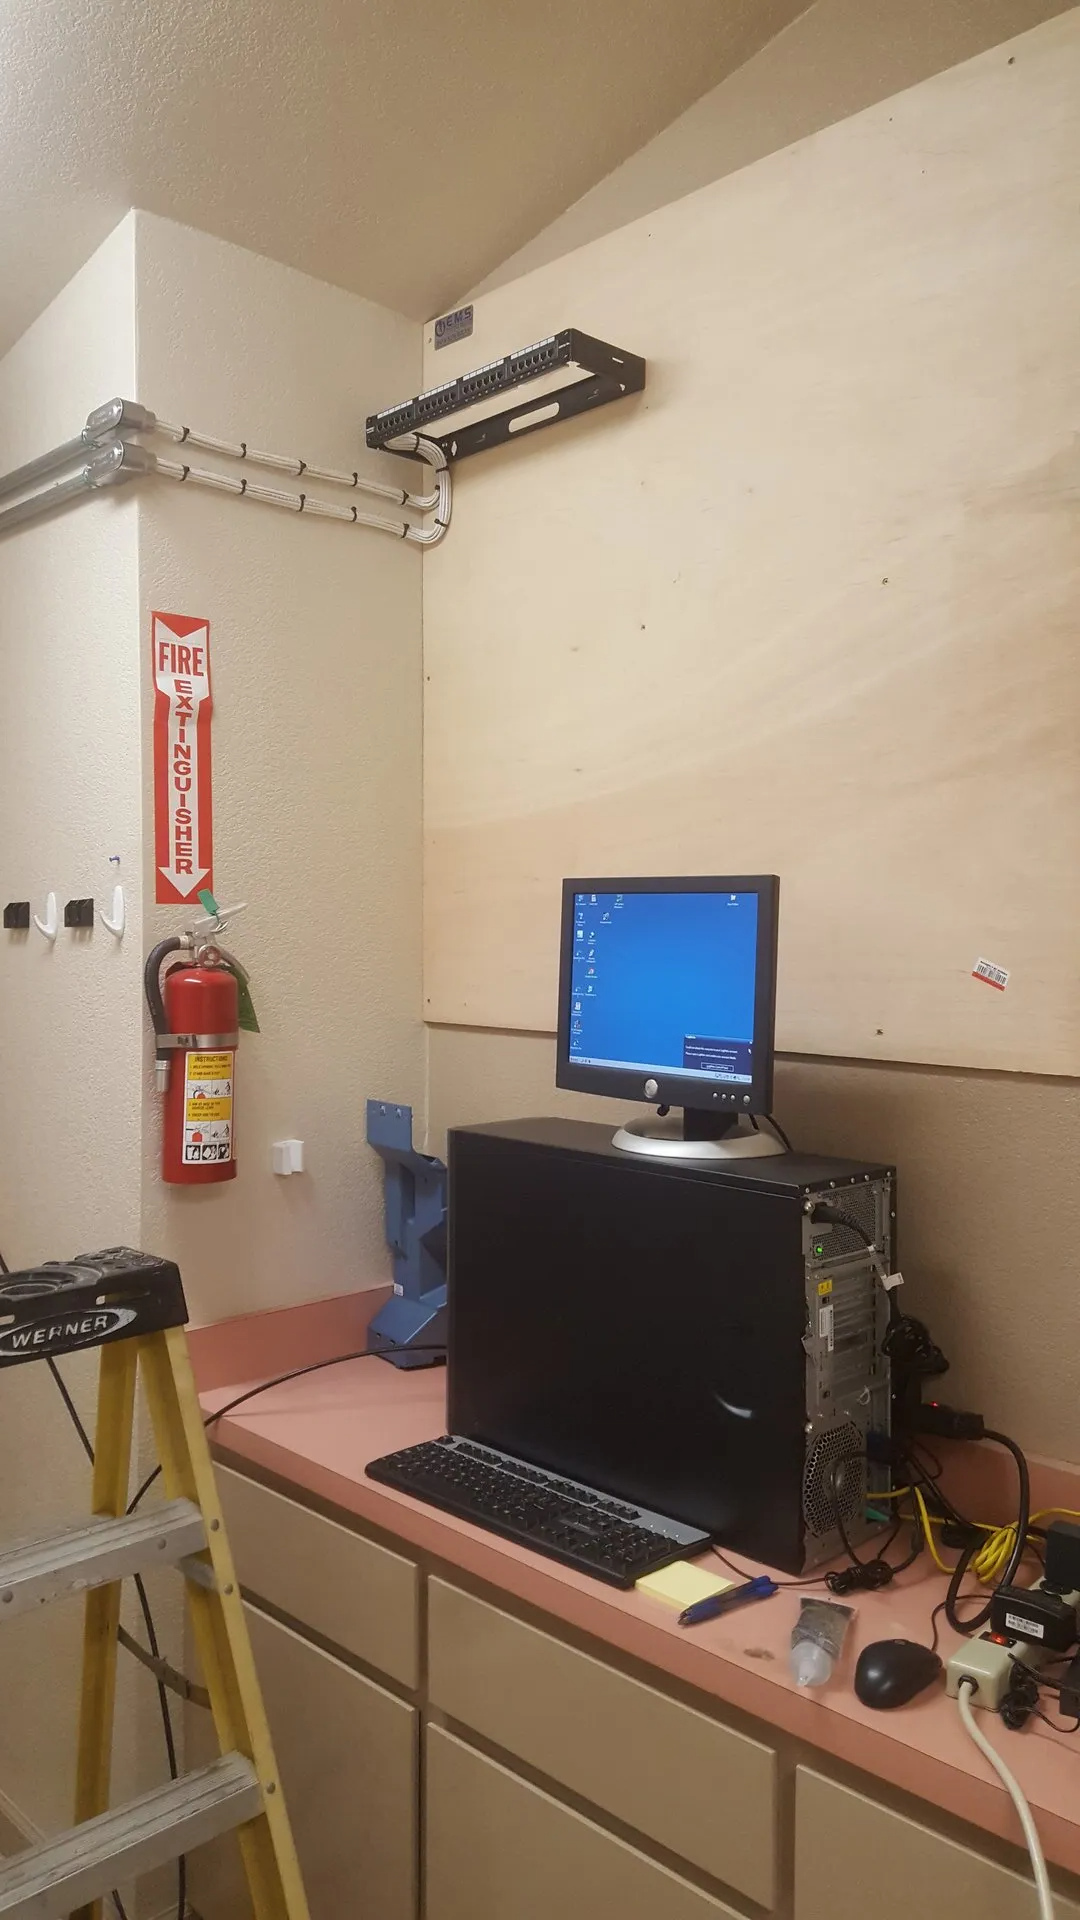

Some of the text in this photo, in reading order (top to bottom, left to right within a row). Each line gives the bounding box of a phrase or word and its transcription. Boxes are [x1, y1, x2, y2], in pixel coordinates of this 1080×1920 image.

[158, 641, 205, 677] FIRE
[173, 679, 194, 875] EXTINGUISHER
[12, 1314, 109, 1349] WERNER
